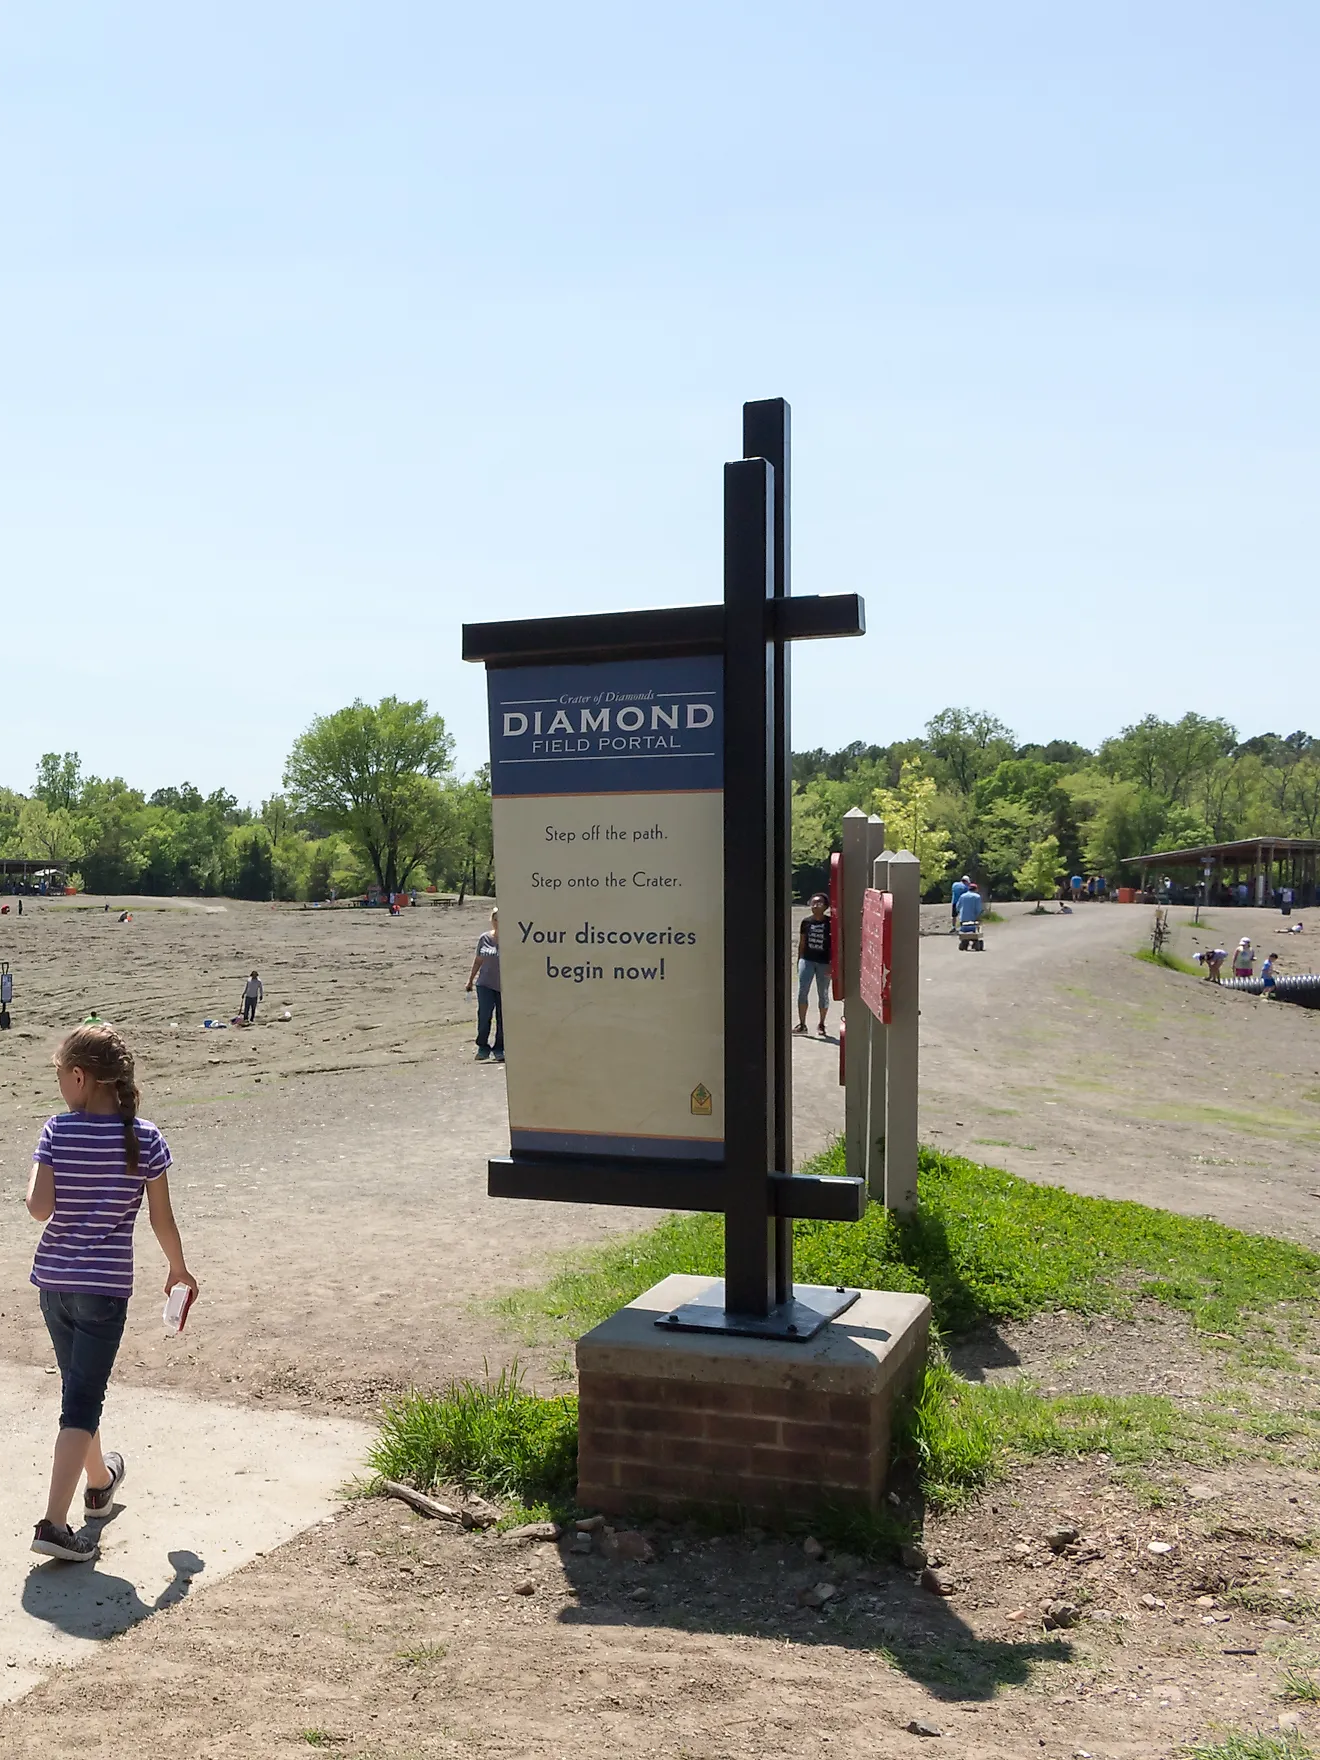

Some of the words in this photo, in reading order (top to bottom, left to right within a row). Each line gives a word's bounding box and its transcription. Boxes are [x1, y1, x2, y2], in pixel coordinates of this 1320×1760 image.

[559, 693, 592, 705] Crater
[593, 691, 604, 706] of
[605, 689, 655, 703] Diamonds
[502, 703, 715, 737] DIAMOND
[532, 738, 590, 754] FIELD
[598, 735, 682, 751] PORTAL
[545, 825, 576, 844] Step
[581, 824, 601, 841] off
[605, 824, 627, 840] the
[632, 823, 668, 843] path.
[531, 872, 562, 890] Step
[567, 875, 600, 888] onto
[605, 871, 627, 887] the
[632, 871, 682, 887] Crater.
[517, 921, 567, 944] Your
[574, 921, 697, 945] discoveries
[546, 956, 604, 984] begin
[613, 957, 666, 980] now!
